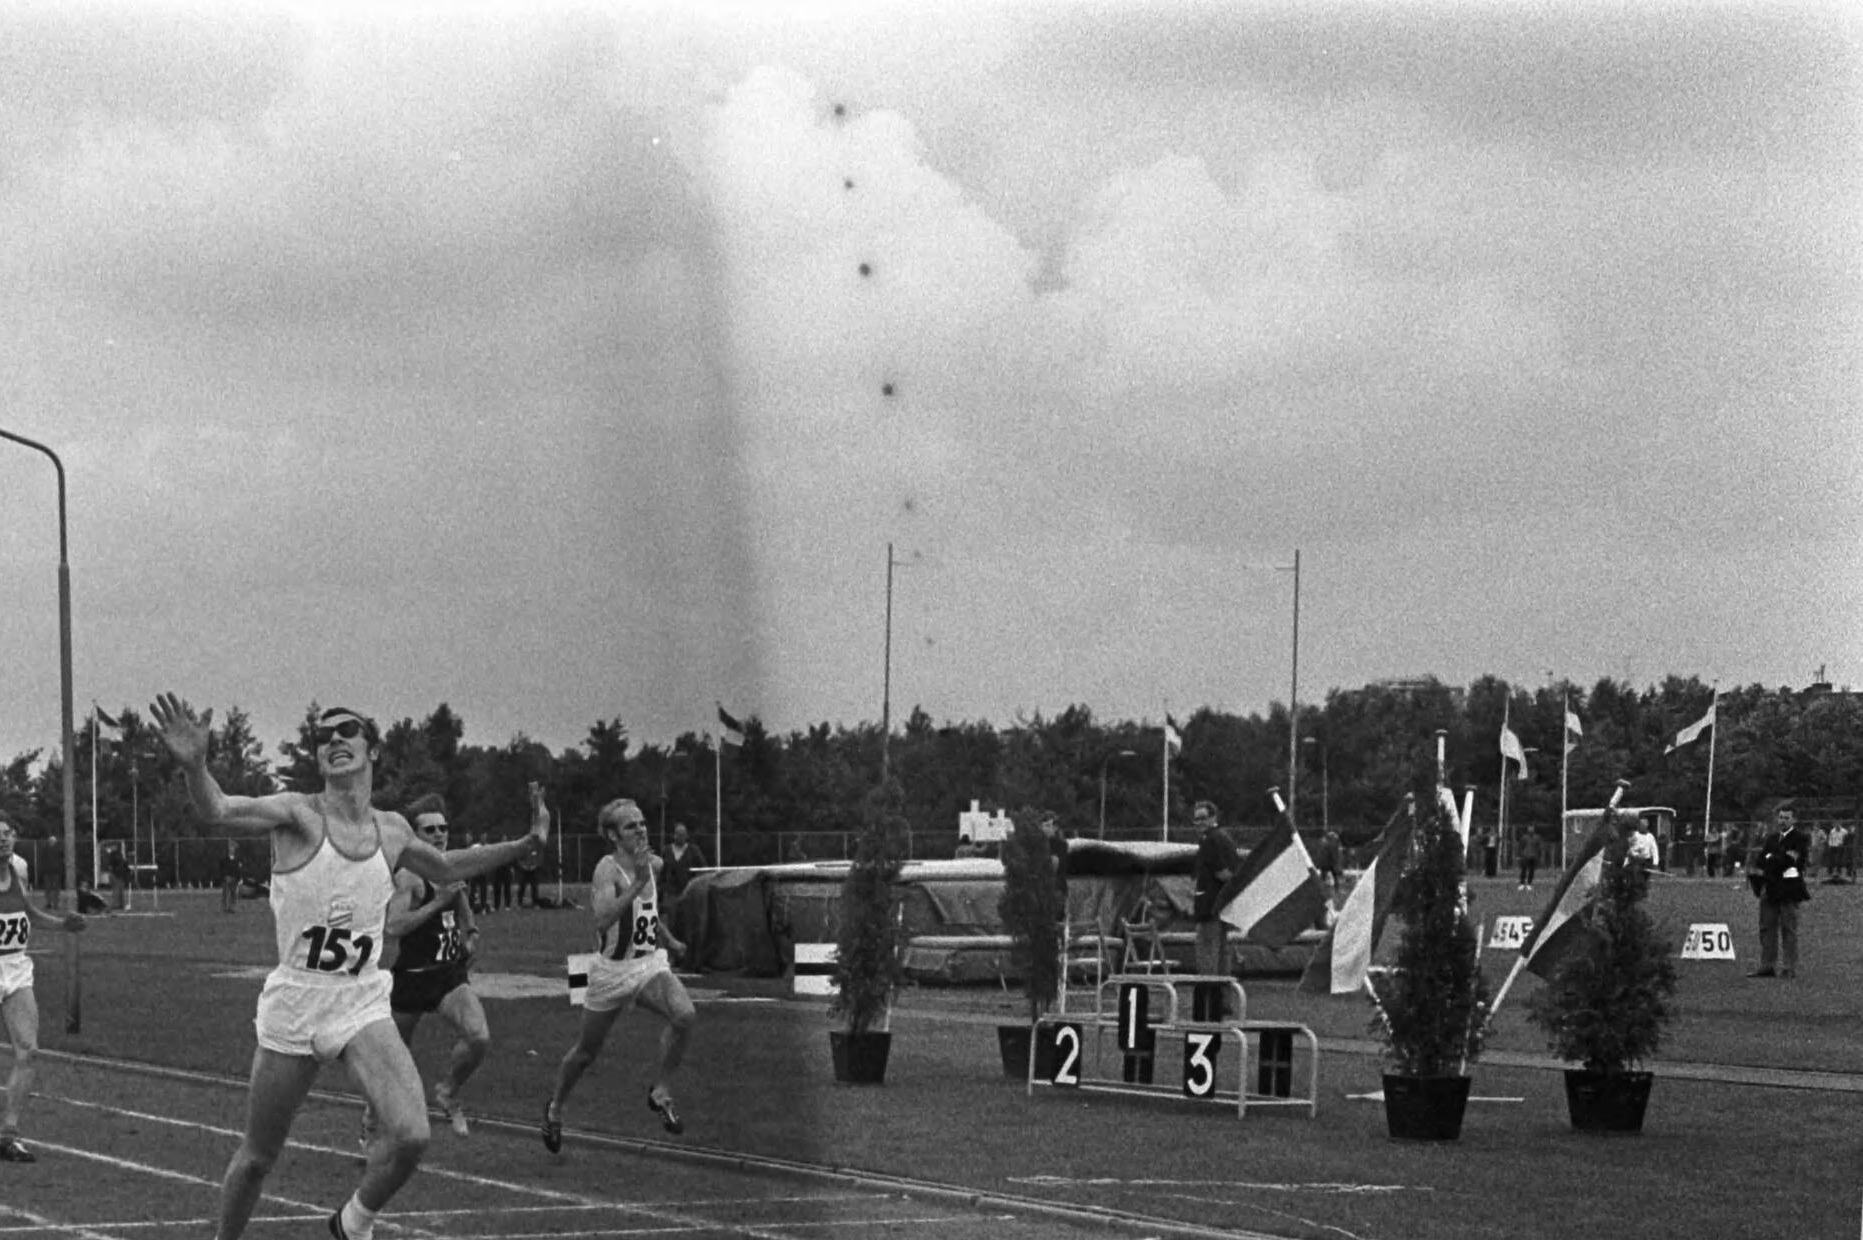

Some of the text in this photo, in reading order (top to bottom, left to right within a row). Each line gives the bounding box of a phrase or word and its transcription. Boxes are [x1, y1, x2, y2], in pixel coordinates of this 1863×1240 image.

[302, 925, 374, 976] 151
[1701, 930, 1731, 952] 50
[1127, 988, 1138, 1048] 1
[1055, 1026, 1080, 1085] 2
[1187, 1034, 1214, 1096] 3
